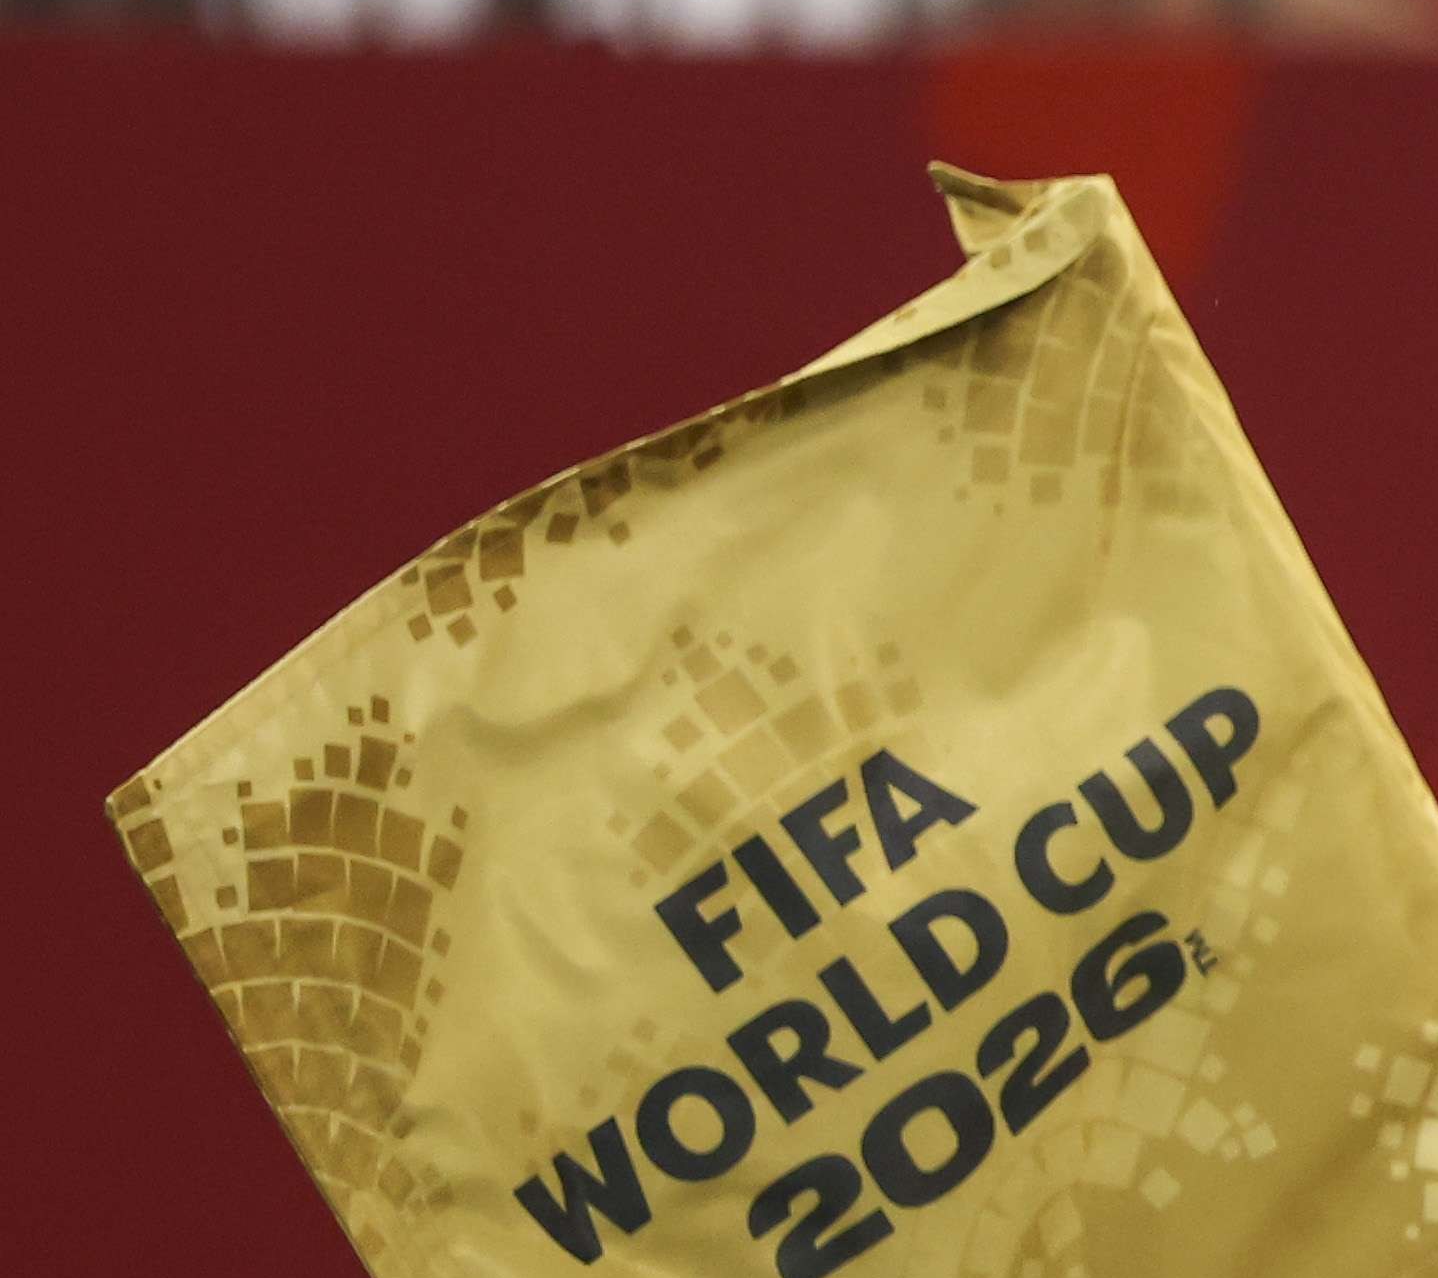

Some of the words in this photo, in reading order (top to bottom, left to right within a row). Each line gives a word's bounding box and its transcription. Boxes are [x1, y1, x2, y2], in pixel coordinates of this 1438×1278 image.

[512, 888, 1010, 1267] WORLD
[1013, 687, 1260, 916] CUP
[653, 748, 978, 995] FIFA
